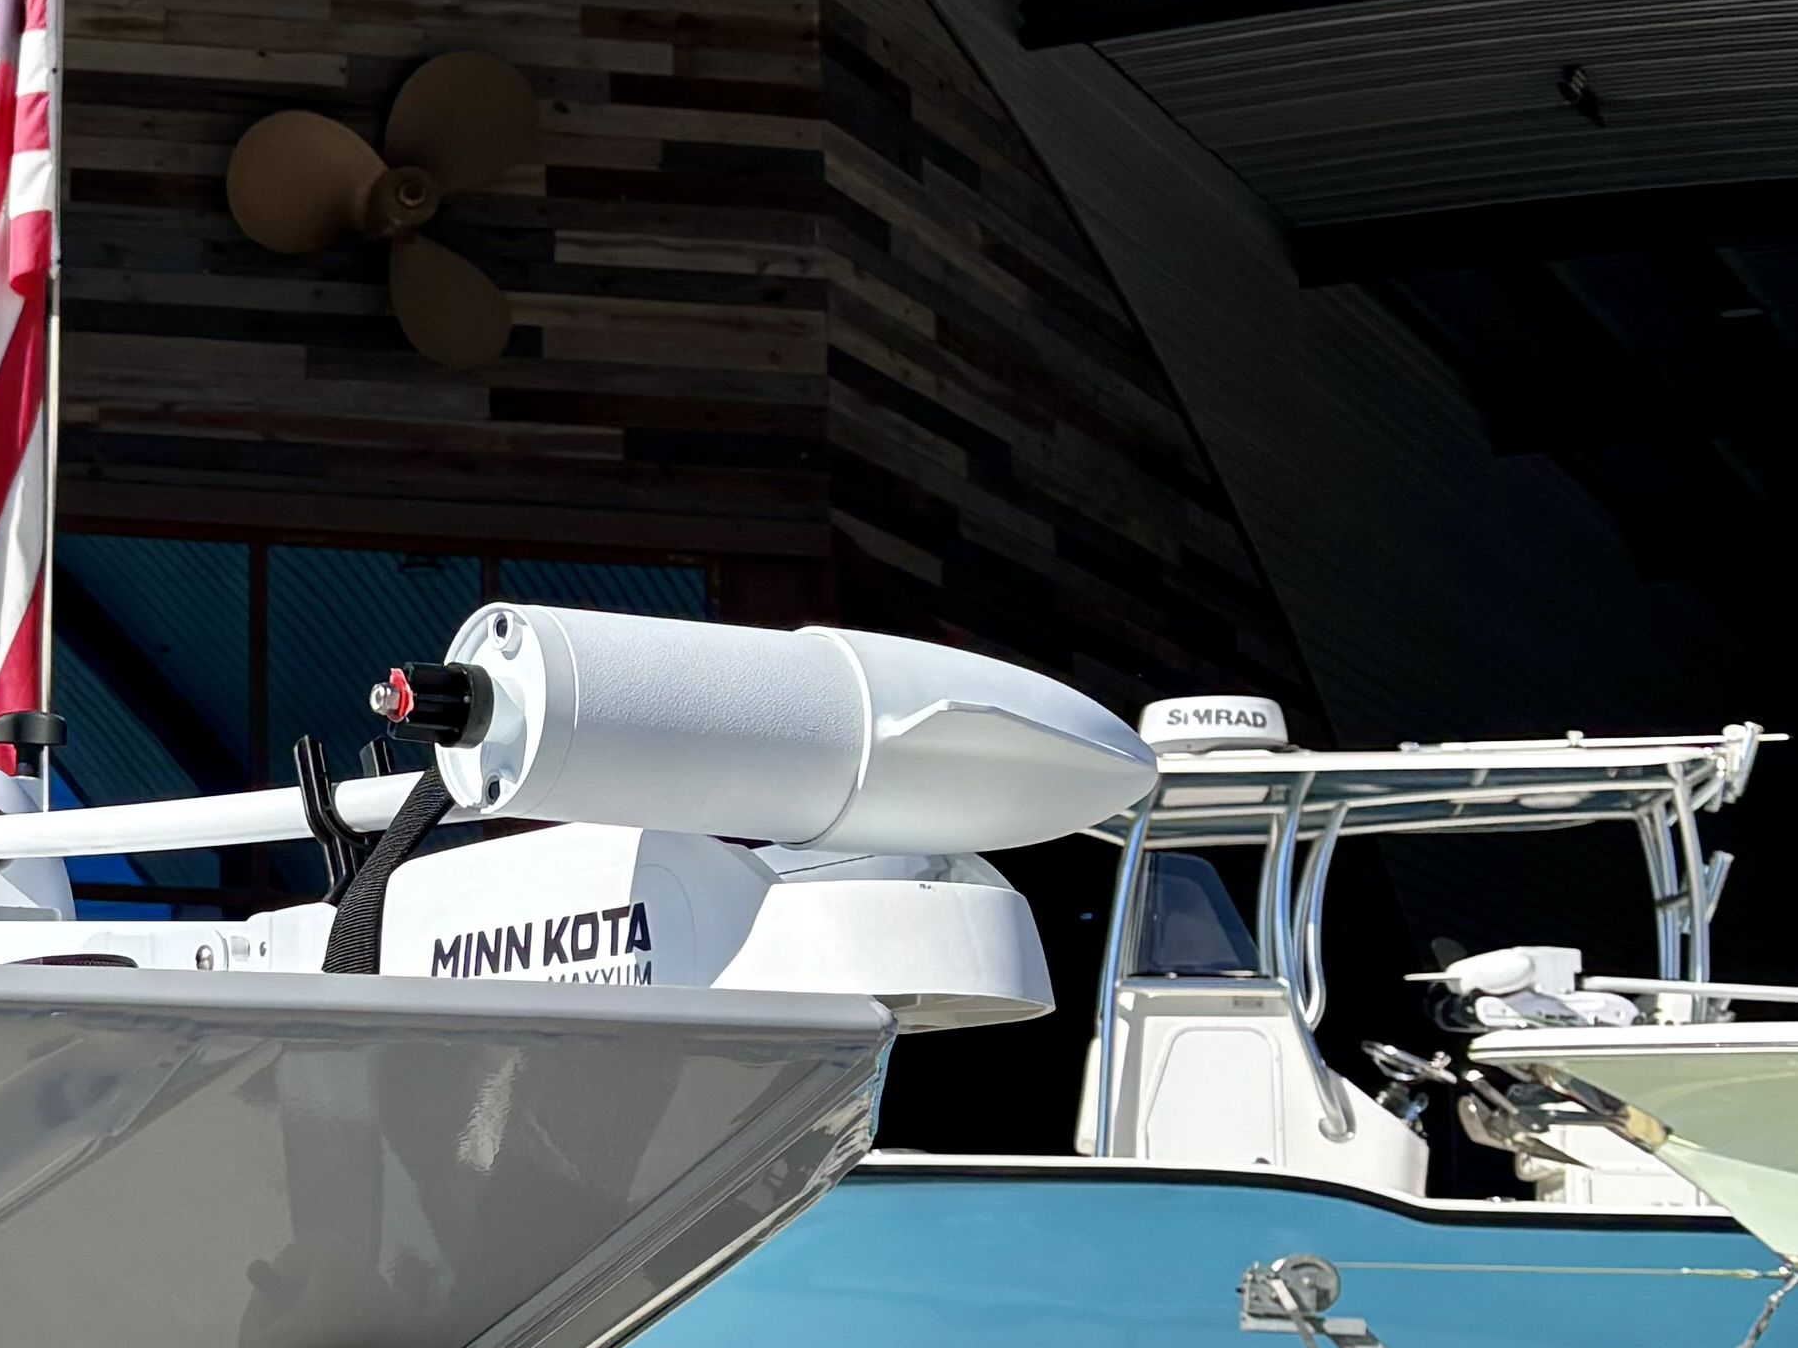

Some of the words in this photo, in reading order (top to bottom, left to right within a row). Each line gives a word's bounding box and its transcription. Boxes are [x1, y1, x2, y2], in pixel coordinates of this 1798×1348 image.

[1166, 708, 1267, 729] SIMRAD
[431, 922, 533, 978] MINN
[543, 902, 652, 967] KOTA
